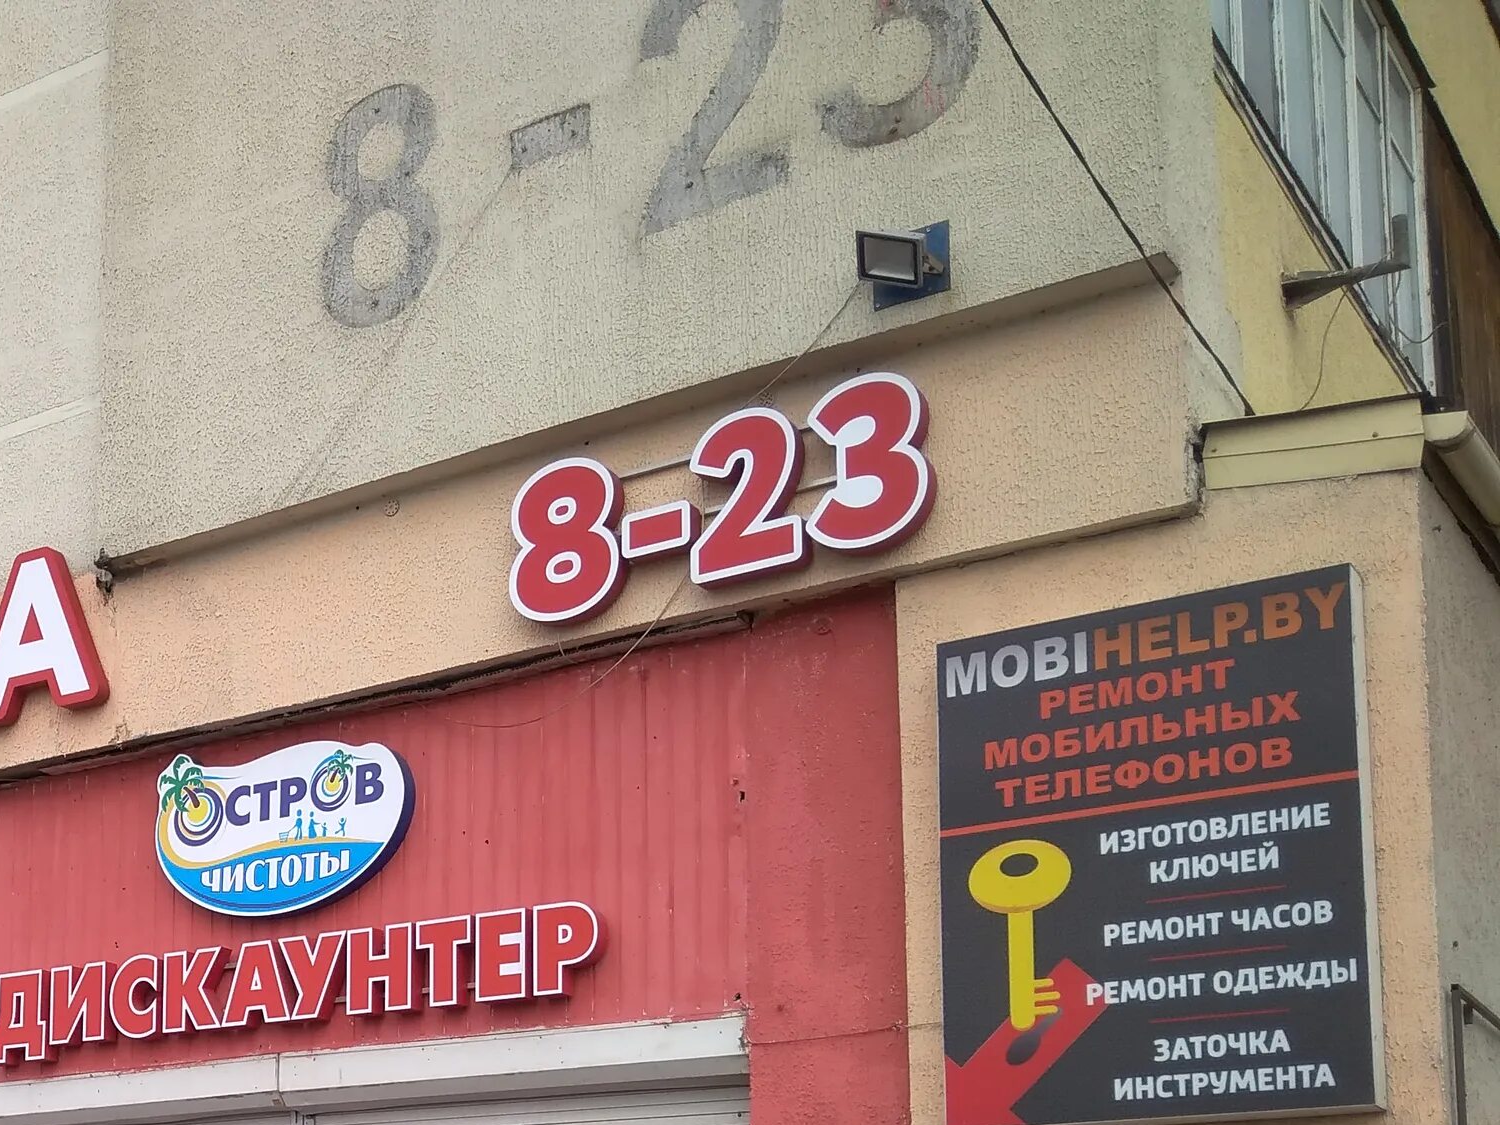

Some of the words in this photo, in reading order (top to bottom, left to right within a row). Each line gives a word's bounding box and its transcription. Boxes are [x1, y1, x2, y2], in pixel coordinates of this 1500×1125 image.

[508, 372, 938, 624] 8-23
[944, 582, 1347, 699] MOBIHELP.BY
[1038, 658, 1235, 720] РЕМОНТ
[983, 690, 1301, 771] МОБИЛЬНЫХ
[994, 736, 1293, 808] ТЕЛЕФОНОВ
[173, 758, 385, 847] ОСТРОВ
[1099, 802, 1331, 855] ИЗГОТОВЛЕНИЕ
[200, 849, 350, 895] ЧИСТОТЫ
[1148, 841, 1280, 884] КЛЮЧЕЙ
[1103, 911, 1223, 947] РЕМОНТ
[1231, 899, 1334, 934] ЧАСОВ
[1085, 972, 1205, 1006] РЕМОНТ
[1212, 957, 1358, 995] ОДЕЖДЫ
[1152, 1028, 1291, 1063] ЗАТОЧКА
[1113, 1063, 1336, 1101] ИНСТРУМЕНТА
